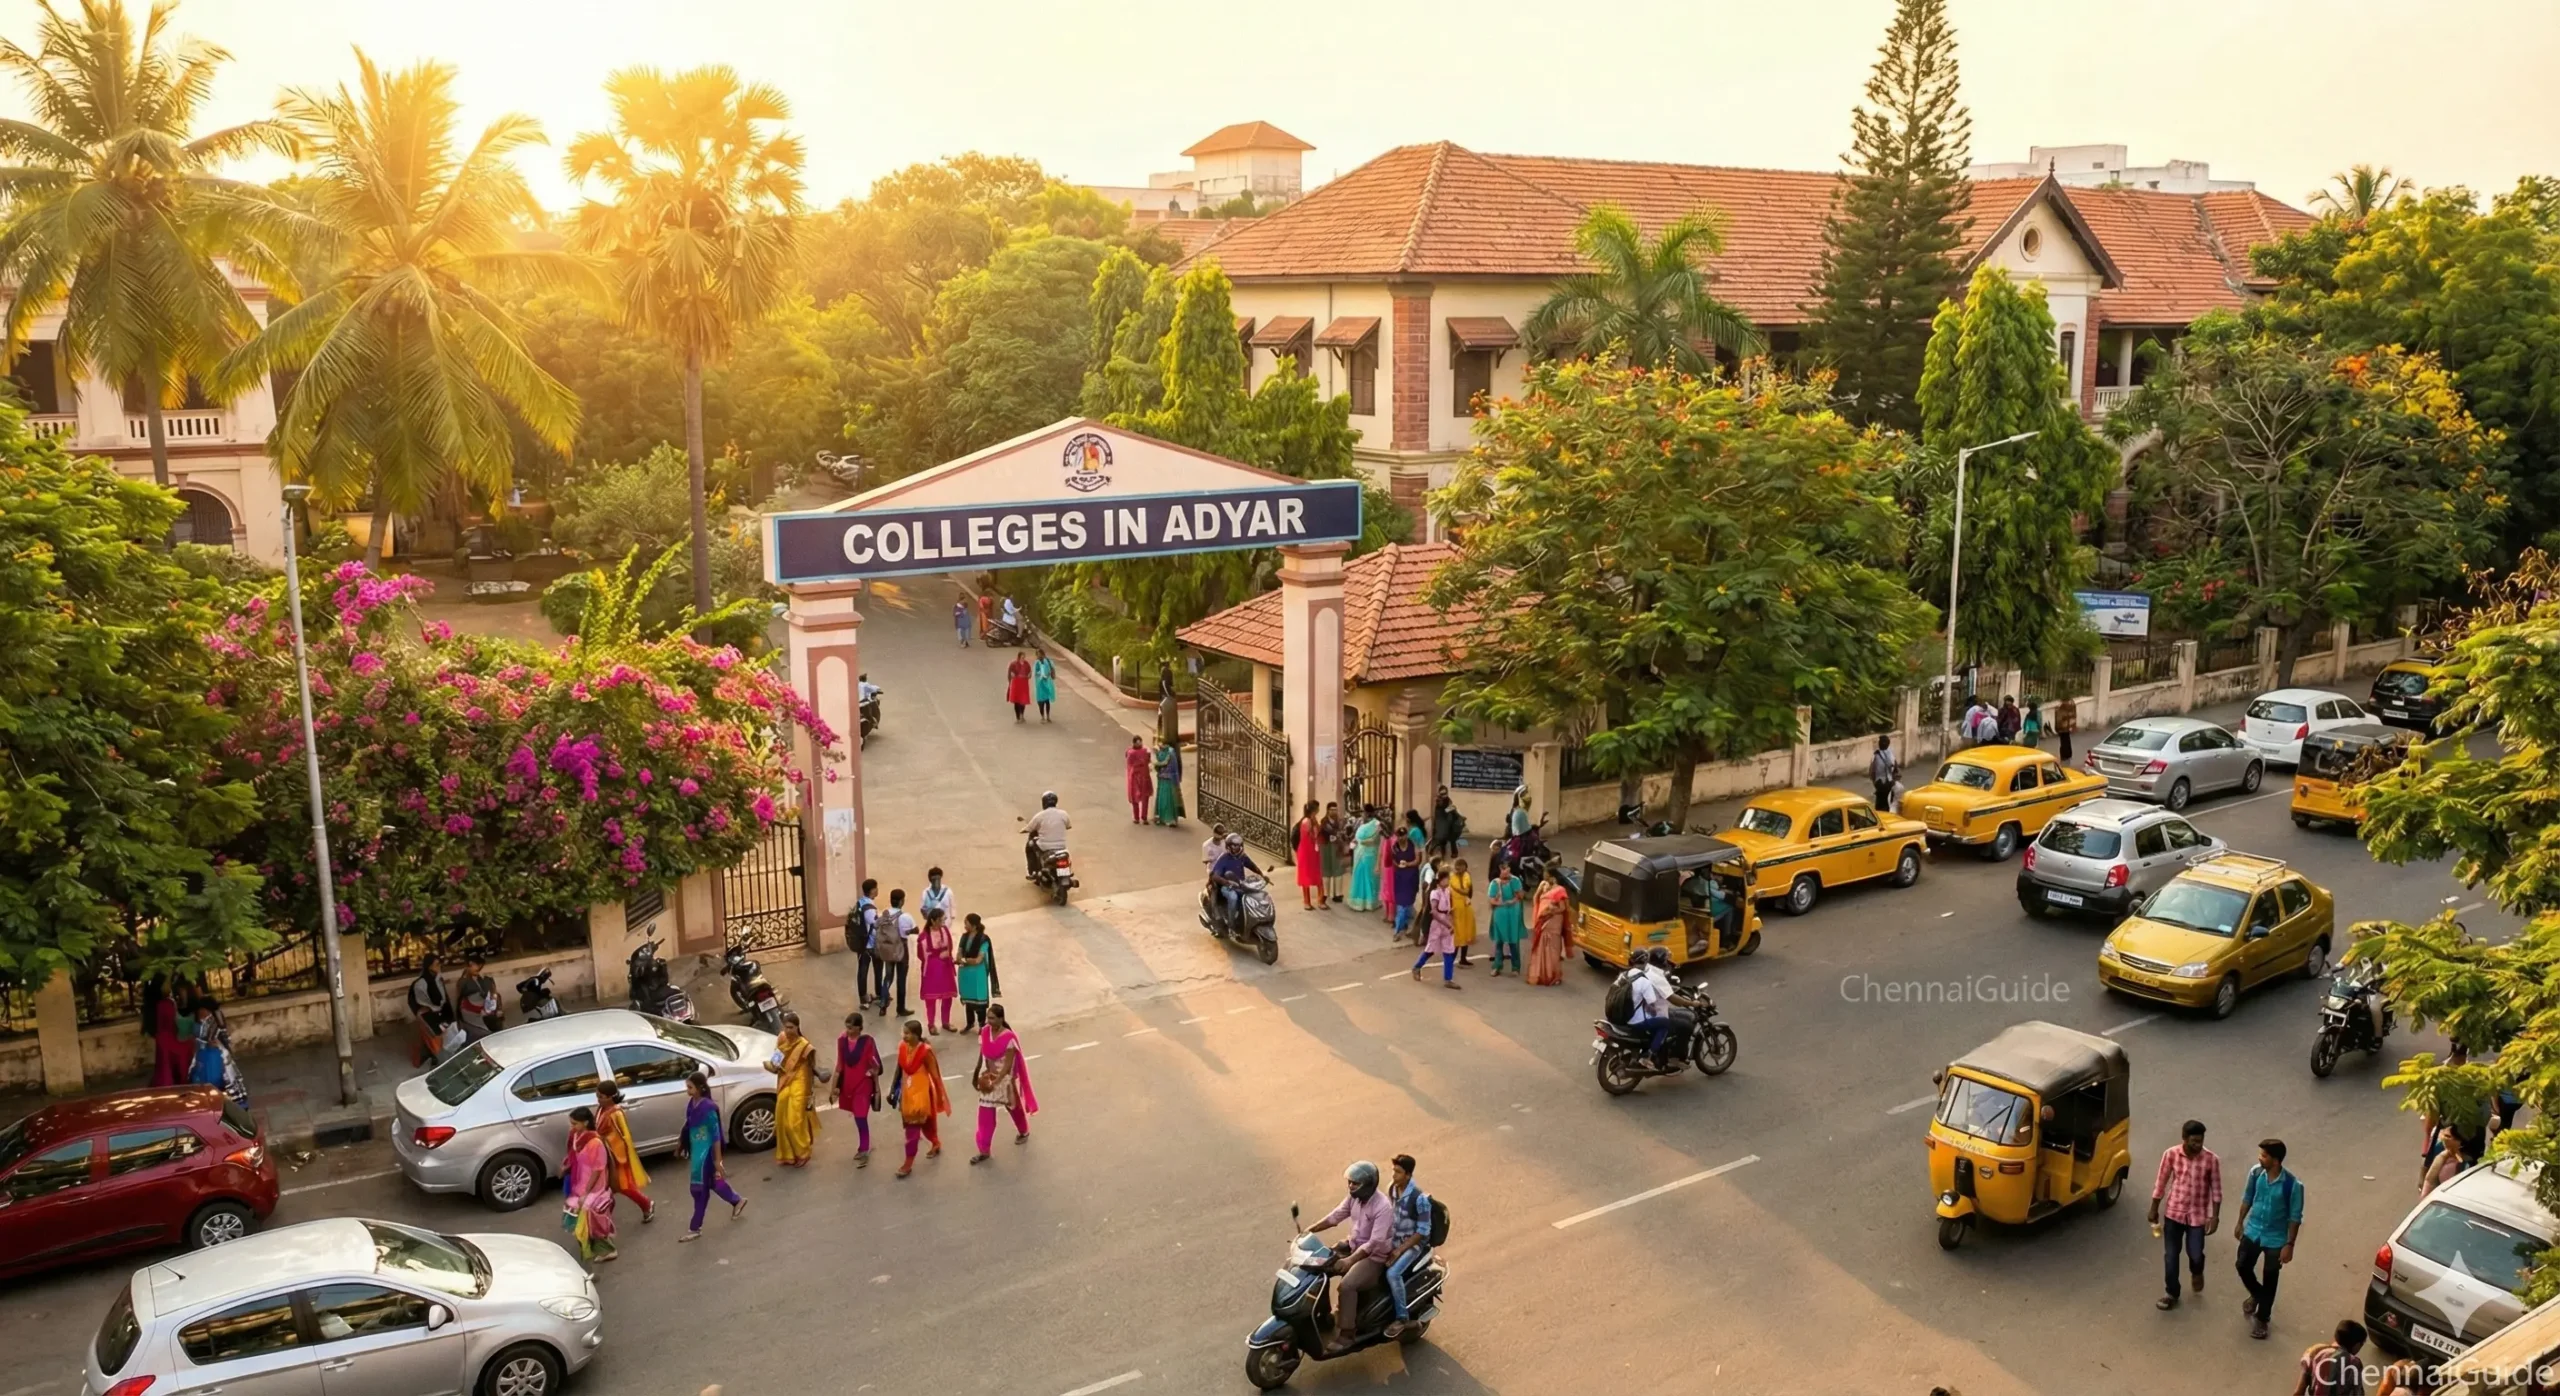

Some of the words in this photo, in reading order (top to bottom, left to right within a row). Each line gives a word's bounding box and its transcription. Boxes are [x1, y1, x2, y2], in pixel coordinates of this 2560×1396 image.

[843, 511, 1087, 564] COLLEGES
[1103, 507, 1148, 546] IN
[1162, 498, 1306, 543] ADYAR
